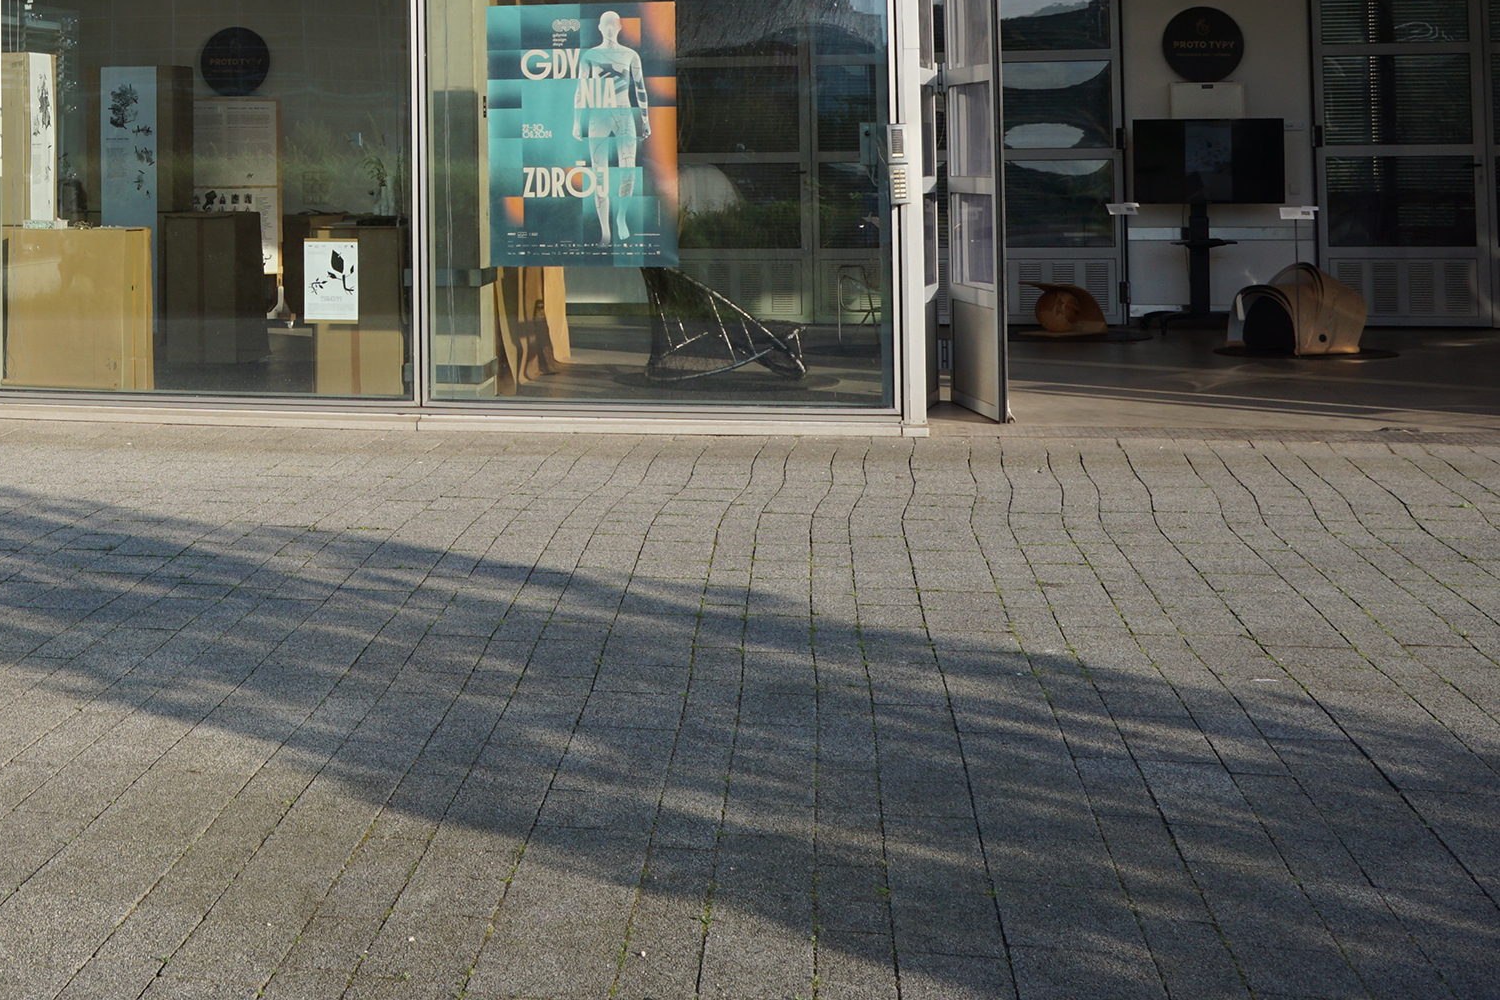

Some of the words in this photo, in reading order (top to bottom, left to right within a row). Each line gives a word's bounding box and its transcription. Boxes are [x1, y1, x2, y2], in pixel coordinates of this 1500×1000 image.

[1173, 41, 1207, 49] PROTO
[1208, 41, 1235, 49] TYPY
[521, 48, 581, 80] GDY
[580, 78, 617, 109] NIA
